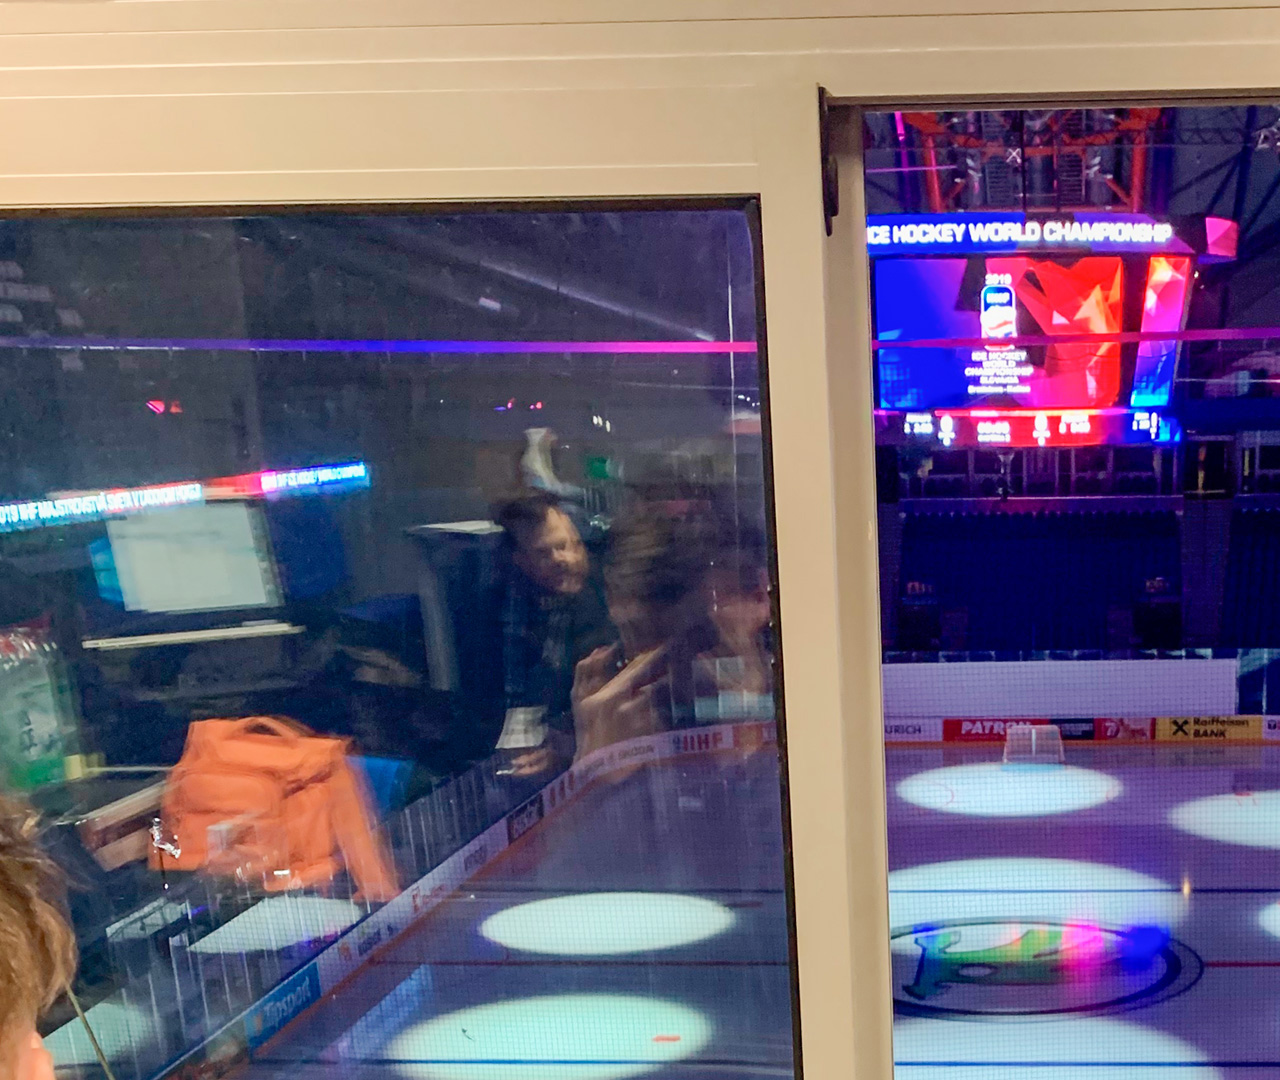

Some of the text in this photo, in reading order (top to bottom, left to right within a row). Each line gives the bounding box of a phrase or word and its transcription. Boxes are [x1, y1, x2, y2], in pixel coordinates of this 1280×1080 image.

[893, 224, 966, 243] HOCKEY
[968, 222, 1041, 242] WORLD
[1043, 222, 1172, 242] CHAMPIONSHIP
[1193, 718, 1249, 728] Raiffeisen
[1193, 729, 1227, 738] BANK
[264, 976, 311, 1021] Tipsport
